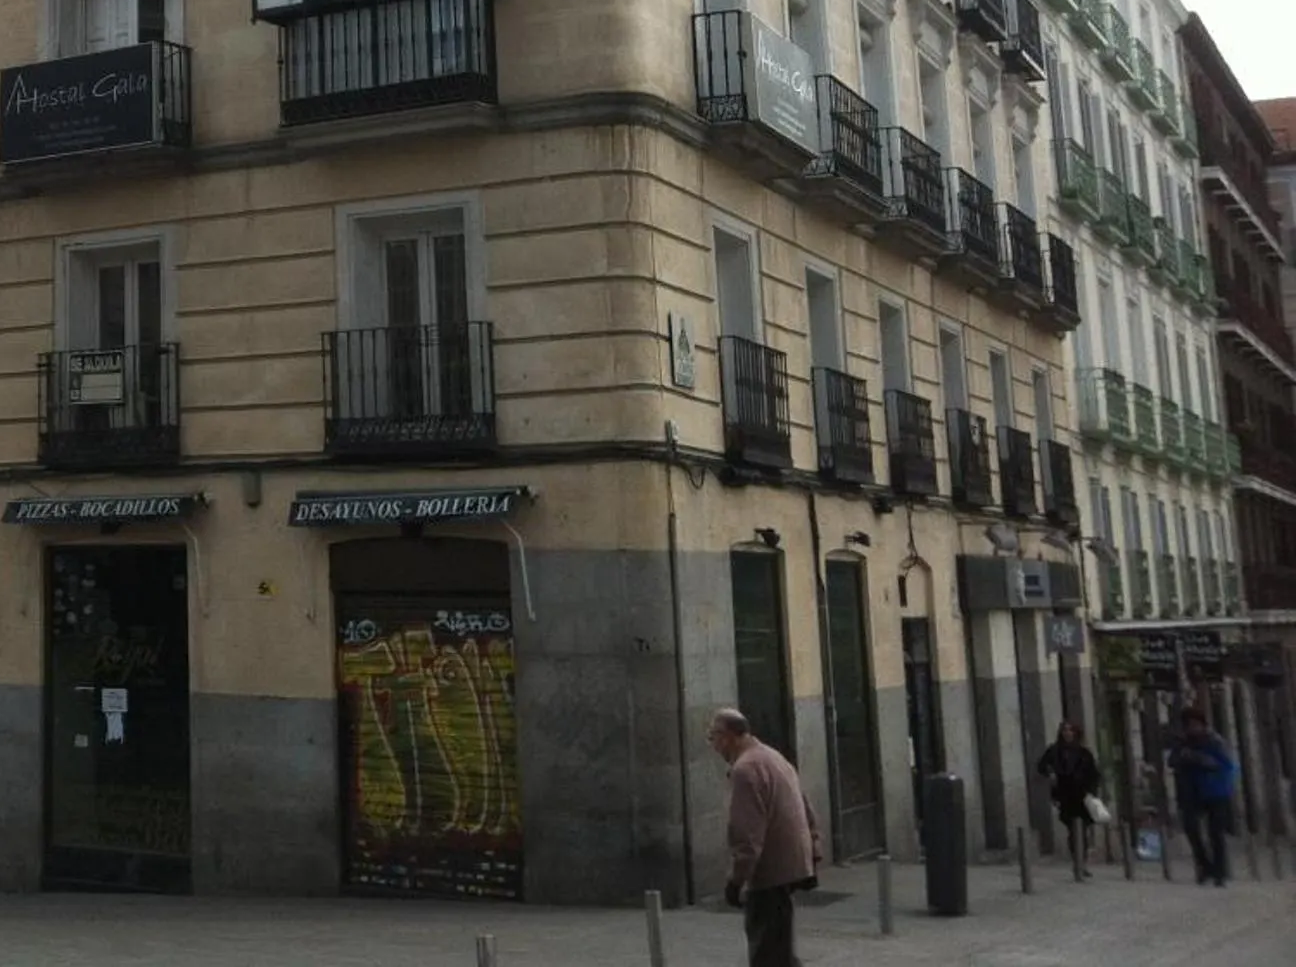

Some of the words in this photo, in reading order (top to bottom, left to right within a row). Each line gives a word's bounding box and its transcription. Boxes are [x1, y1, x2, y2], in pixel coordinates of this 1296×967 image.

[6, 74, 85, 115] Hostal
[92, 72, 148, 103] Gala
[16, 502, 70, 519] PIZZAS
[79, 497, 181, 517] BOCADILLOS
[296, 500, 403, 521] DESAYUNOS
[415, 494, 511, 517] BOLLERIA
